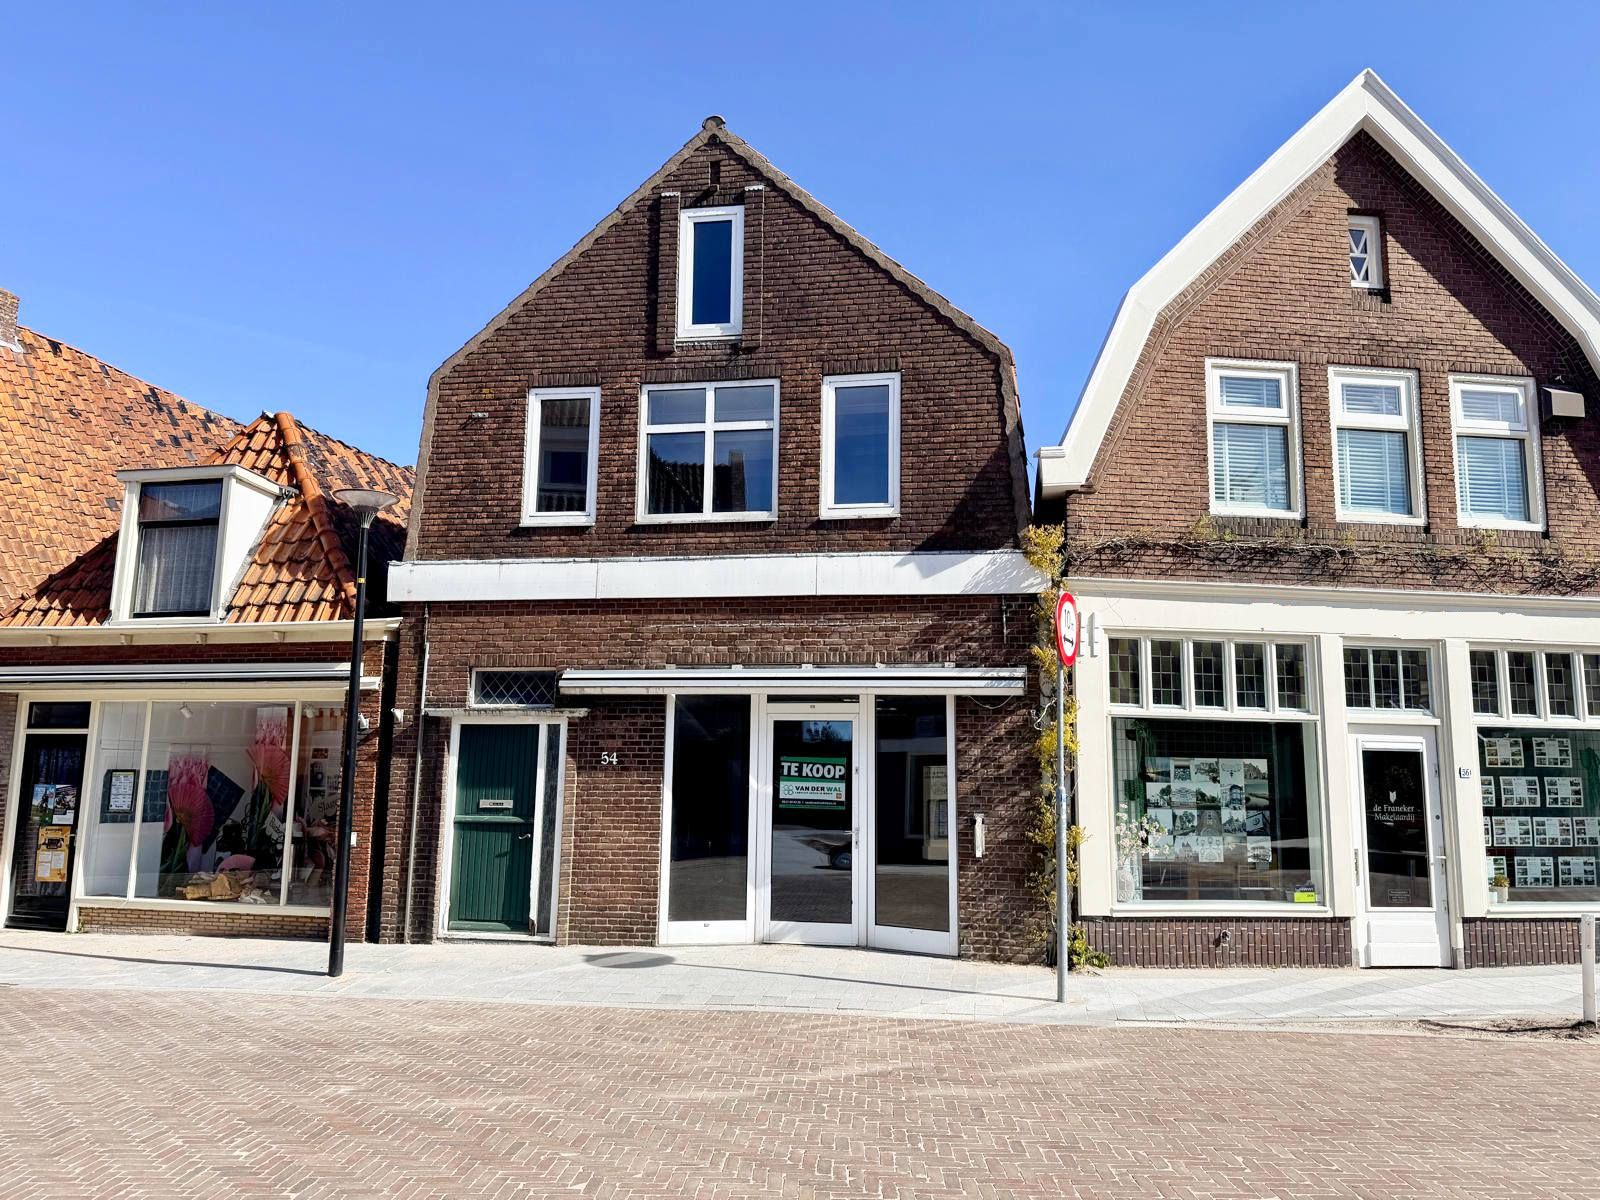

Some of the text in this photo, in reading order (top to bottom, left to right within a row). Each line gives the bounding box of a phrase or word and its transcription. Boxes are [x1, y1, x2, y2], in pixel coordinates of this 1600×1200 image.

[600, 751, 618, 765] 54
[781, 762, 845, 778] TE KOOP
[1383, 804, 1415, 813] Franeker
